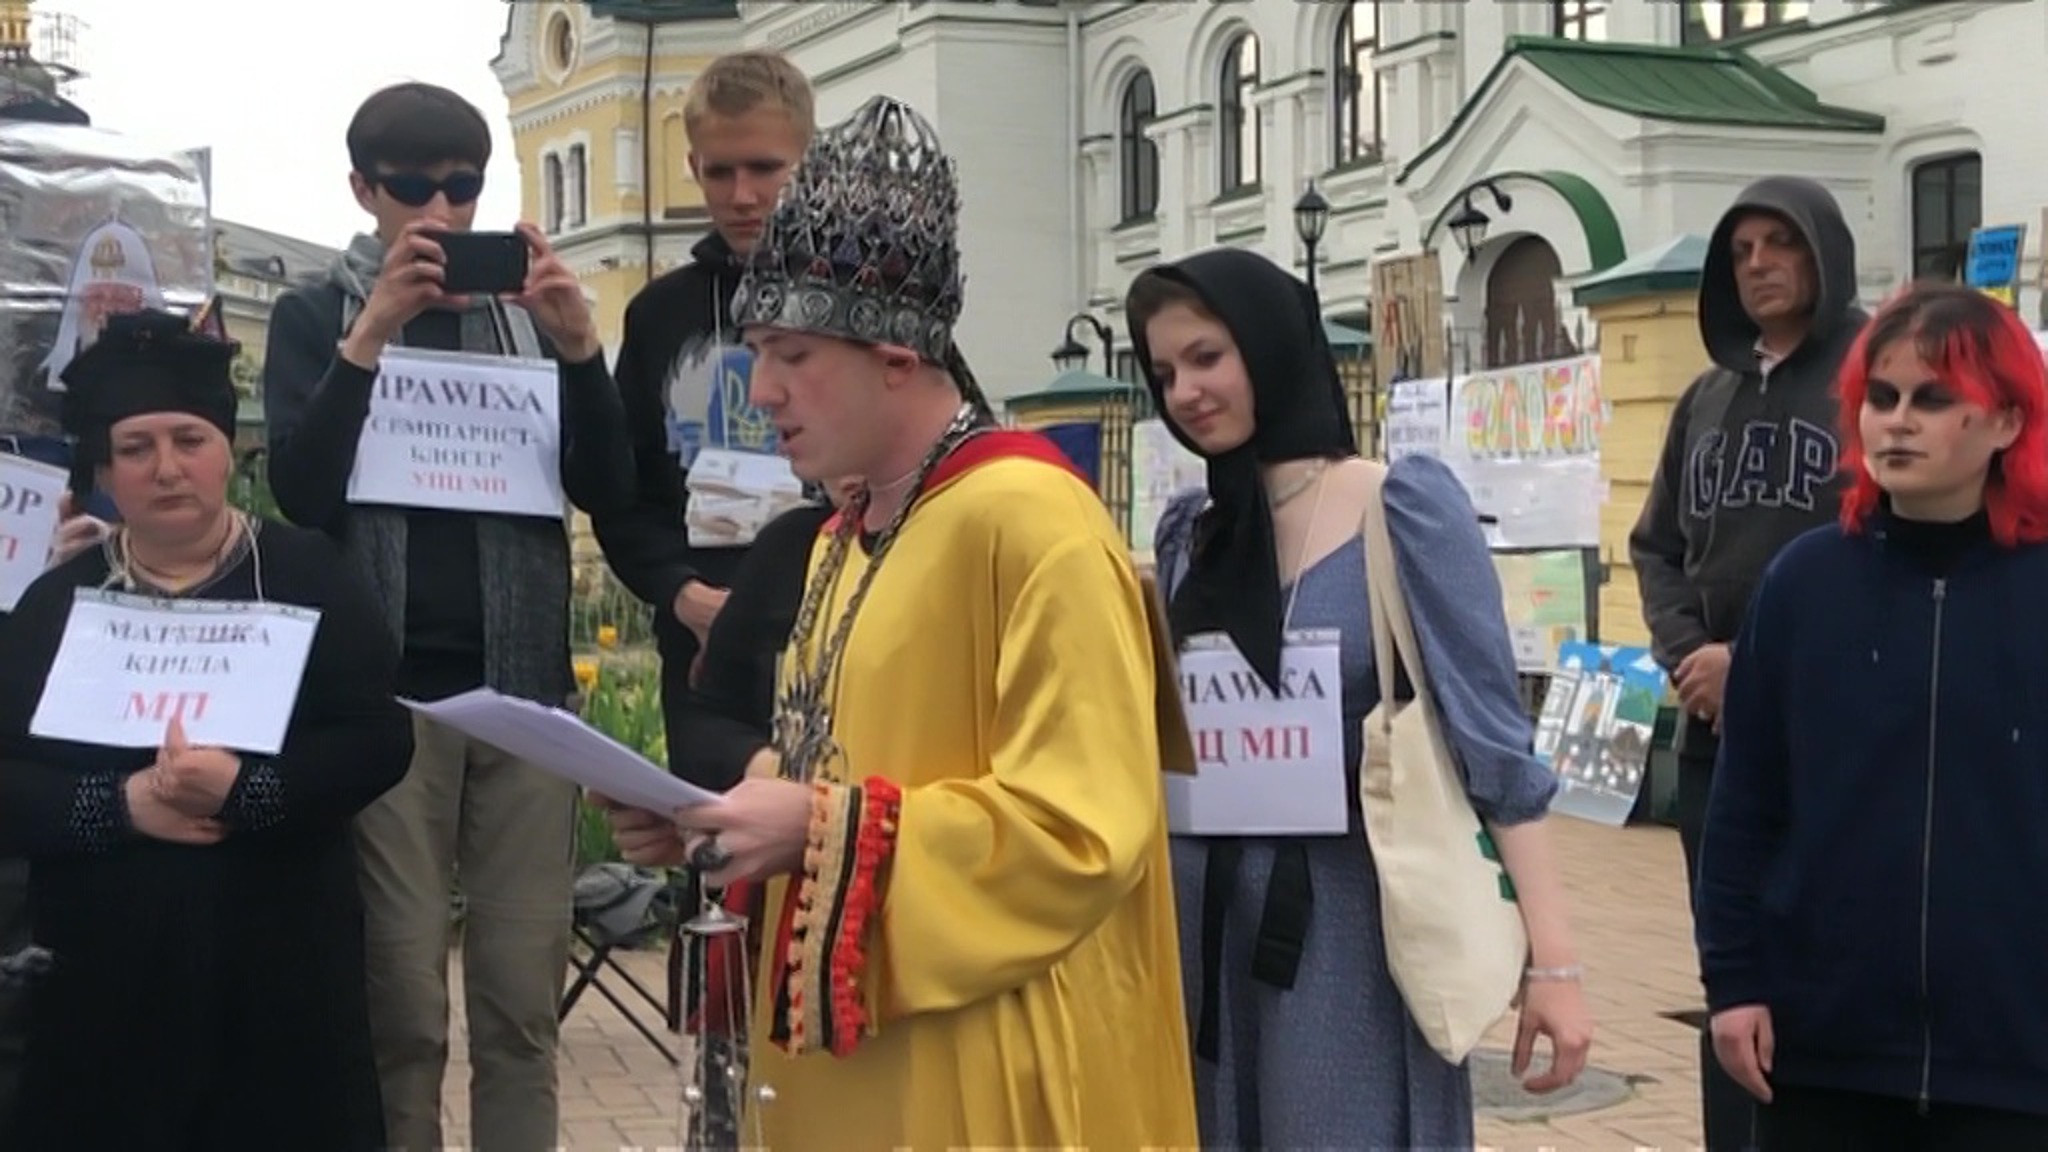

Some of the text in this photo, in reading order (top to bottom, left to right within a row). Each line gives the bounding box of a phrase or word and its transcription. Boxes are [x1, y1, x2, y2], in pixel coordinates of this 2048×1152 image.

[1691, 417, 1838, 519] GAP
[103, 619, 271, 646] МАТУШКА
[121, 690, 209, 722] МП
[1240, 725, 1310, 762] МП
